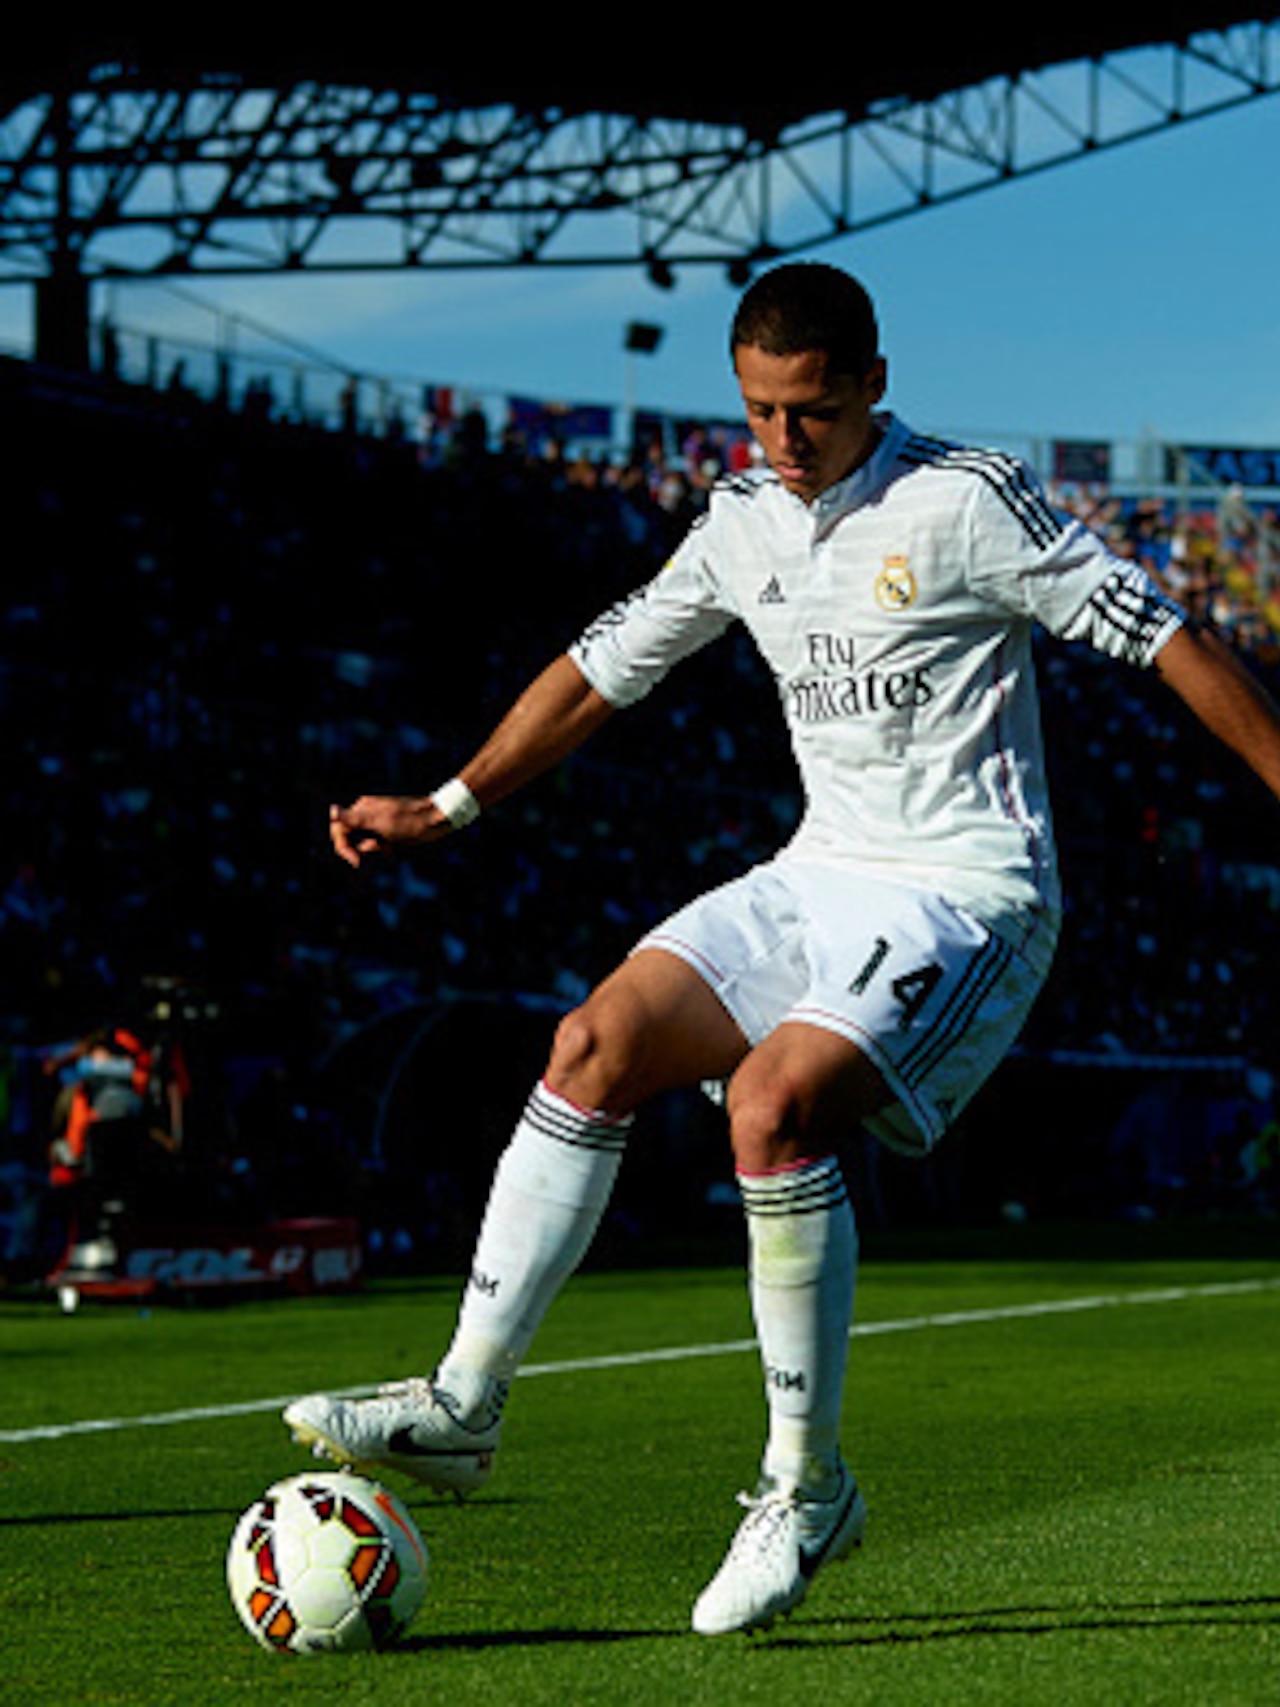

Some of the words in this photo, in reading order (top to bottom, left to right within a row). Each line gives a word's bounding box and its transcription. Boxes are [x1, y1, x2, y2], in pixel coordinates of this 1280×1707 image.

[807, 632, 854, 669] Fly
[787, 667, 933, 722] mirates
[848, 934, 943, 1033] 14
